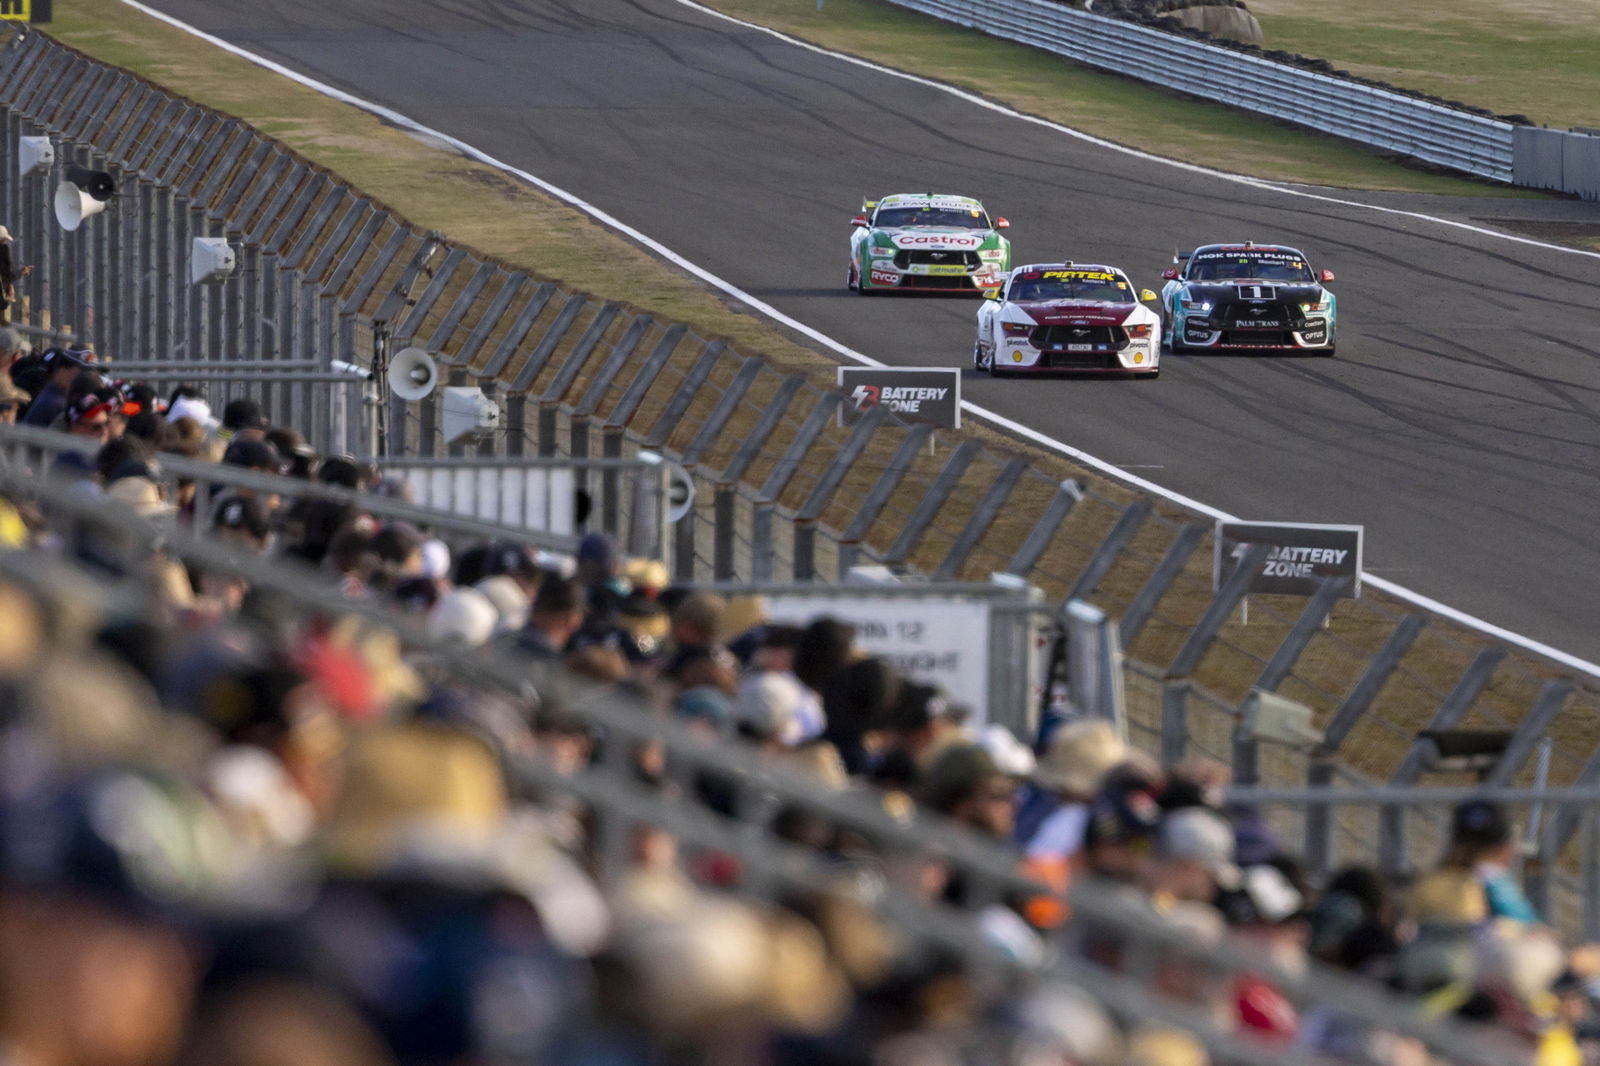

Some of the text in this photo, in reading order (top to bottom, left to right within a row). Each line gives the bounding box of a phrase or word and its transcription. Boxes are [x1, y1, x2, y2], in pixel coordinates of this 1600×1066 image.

[899, 235, 976, 246] Castrol
[1198, 252, 1224, 260] NGK
[1264, 253, 1302, 262] PLUGS
[871, 271, 899, 283] RYCO
[1043, 271, 1115, 281] PIRTEK
[1249, 285, 1262, 298] 1
[1235, 319, 1255, 328] PALM
[1187, 330, 1209, 339] OPTUS
[1304, 330, 1324, 340] OPTUS
[881, 386, 948, 400] BATTERY
[1262, 560, 1314, 577] ZONE
